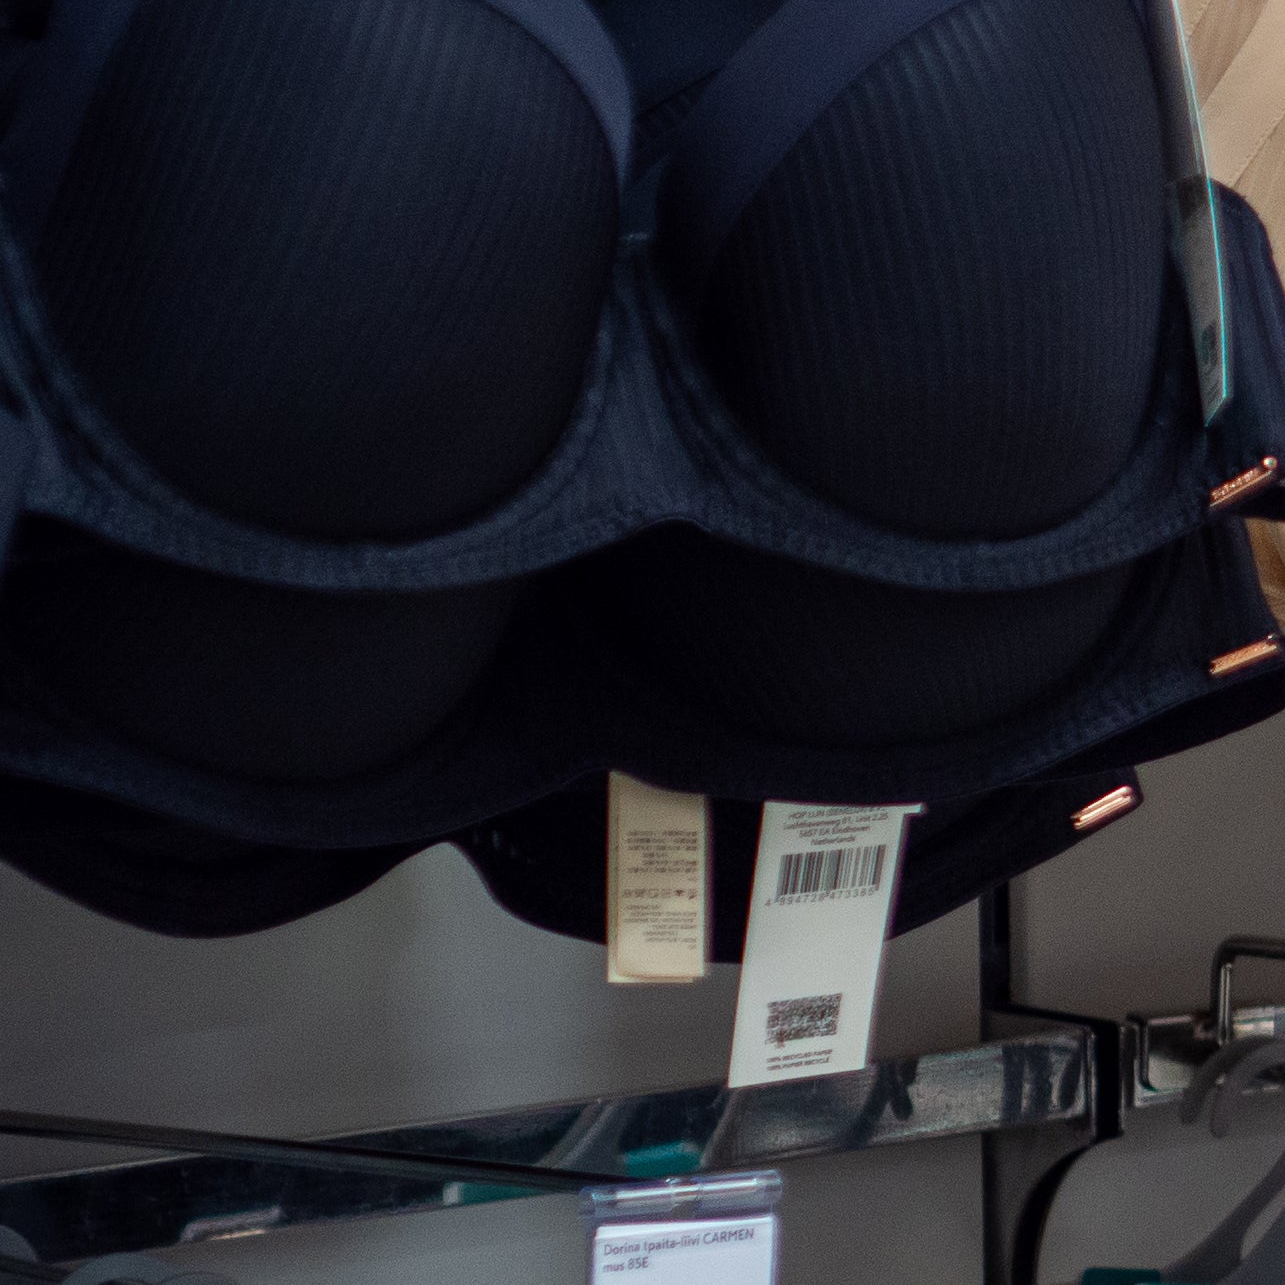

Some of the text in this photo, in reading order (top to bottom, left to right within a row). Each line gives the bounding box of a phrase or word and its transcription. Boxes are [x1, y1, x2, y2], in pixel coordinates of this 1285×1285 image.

[604, 1241, 640, 1256] Dorina
[703, 1228, 755, 1244] CARMEN
[603, 1256, 649, 1272] mus 85E
